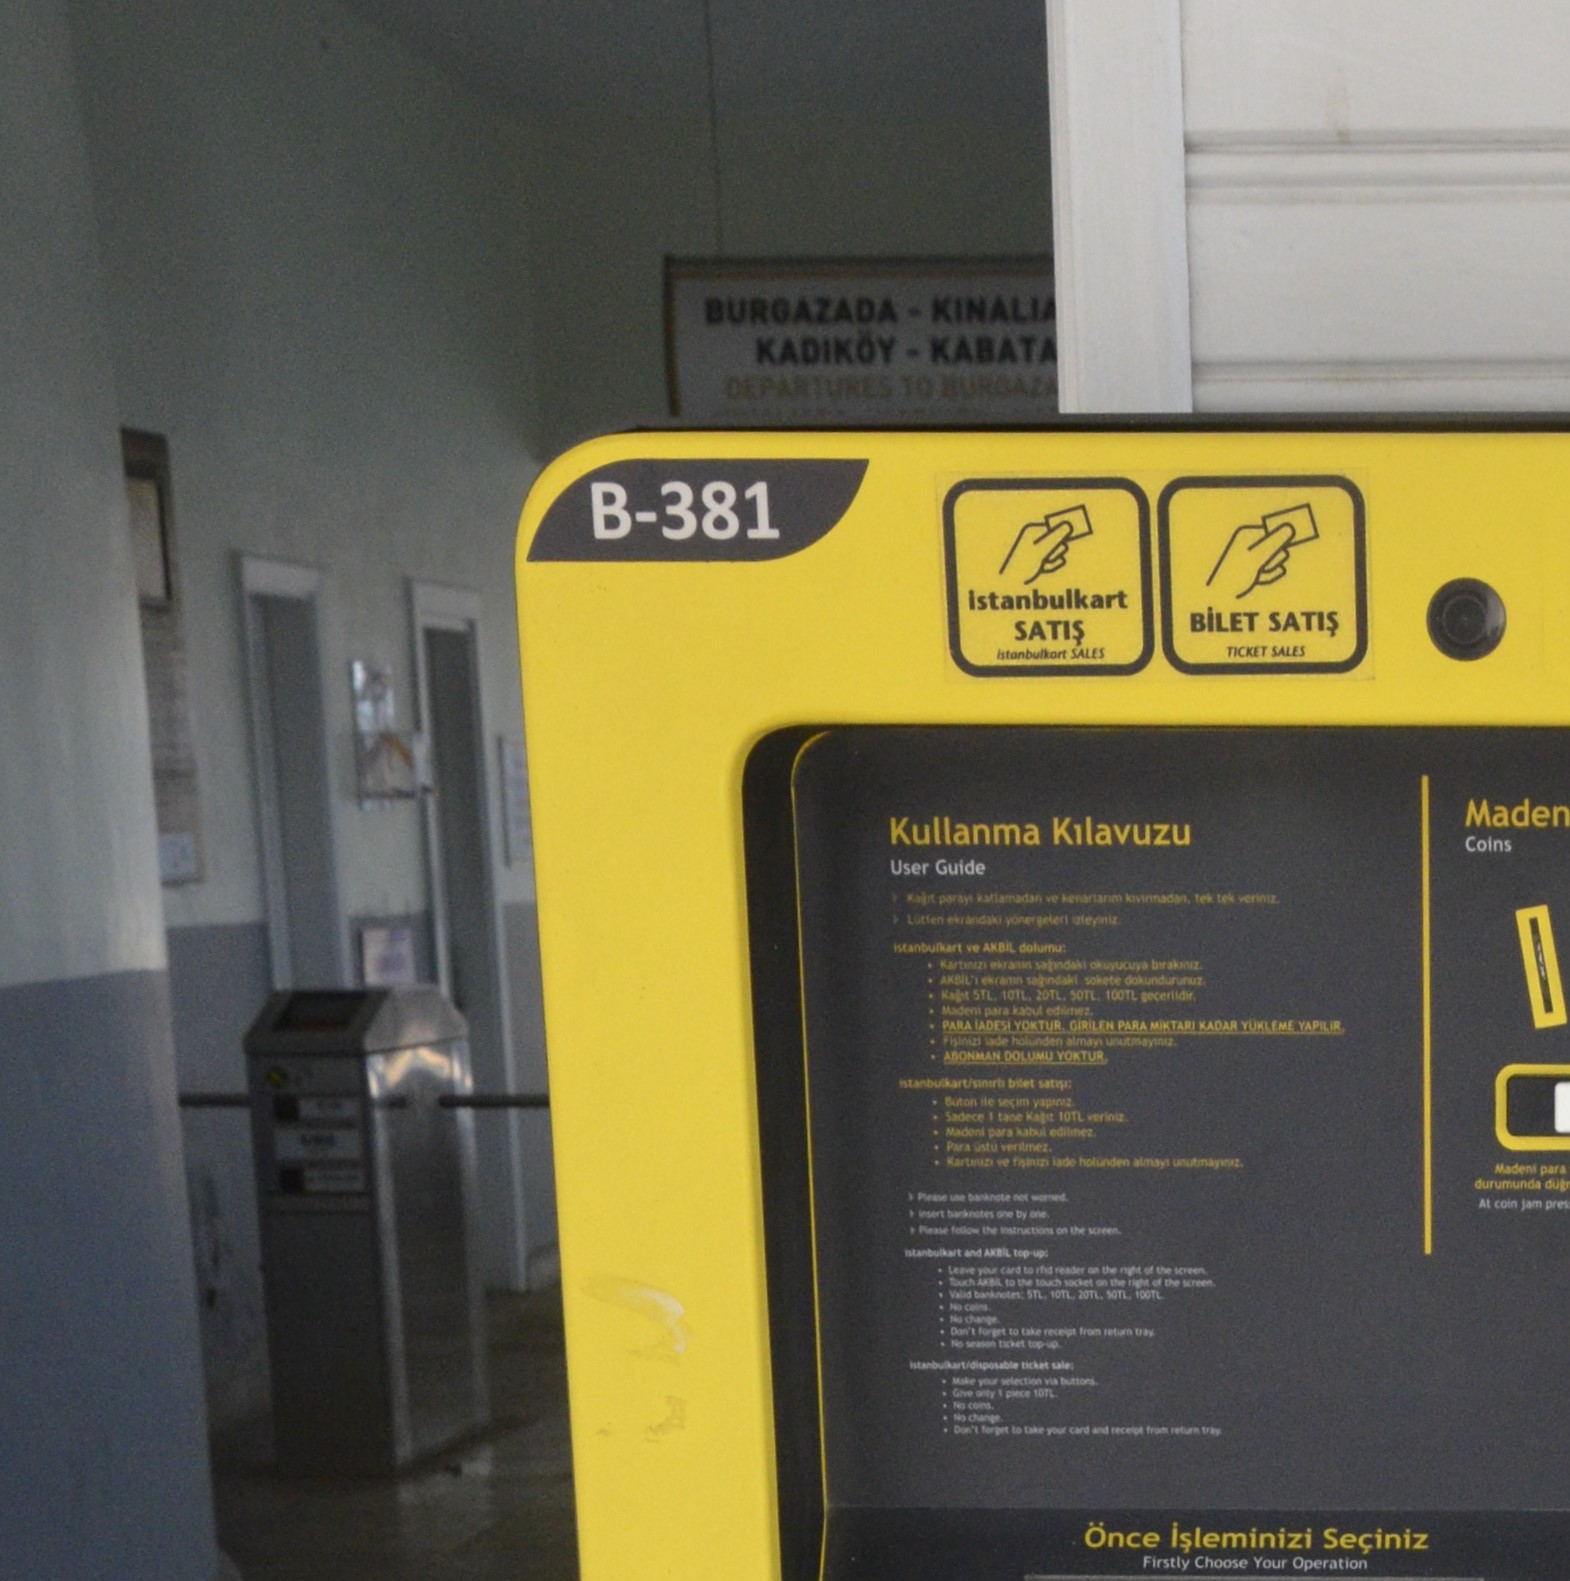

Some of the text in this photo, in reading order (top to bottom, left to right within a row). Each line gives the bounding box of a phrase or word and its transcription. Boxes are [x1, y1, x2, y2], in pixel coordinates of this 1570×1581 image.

[704, 296, 899, 326] BURGAZADA
[756, 331, 897, 366] KADIKÖY
[590, 480, 781, 541] B-381
[968, 588, 1129, 611] istanbulkart
[1190, 606, 1340, 638] BİLET SATIŞ
[1014, 619, 1086, 647] SATIŞ
[1227, 645, 1306, 658] TICKET SALES
[890, 816, 1192, 846] Kullanma Kılavuzu
[1465, 835, 1513, 853] Coins
[890, 858, 987, 876] User Guide
[943, 1020, 972, 1031] PARA
[1118, 1020, 1148, 1031] PARA
[1199, 1020, 1238, 1031] KADAR
[1242, 1020, 1295, 1031] YÜKLEME
[945, 1050, 1002, 1062] ABONMAN
[1004, 1050, 1054, 1062] DOLUMU
[1494, 1163, 1538, 1175] Madeni
[1540, 1165, 1568, 1177] para
[1474, 1178, 1543, 1190] durumunda
[1478, 1198, 1492, 1209] At
[1494, 1199, 1519, 1210] coin
[1521, 1199, 1544, 1211] jam
[1084, 1521, 1430, 1555] Önce İşleminizi Seçiniz
[1143, 1555, 1369, 1572] Firstly Choose Your Operation
